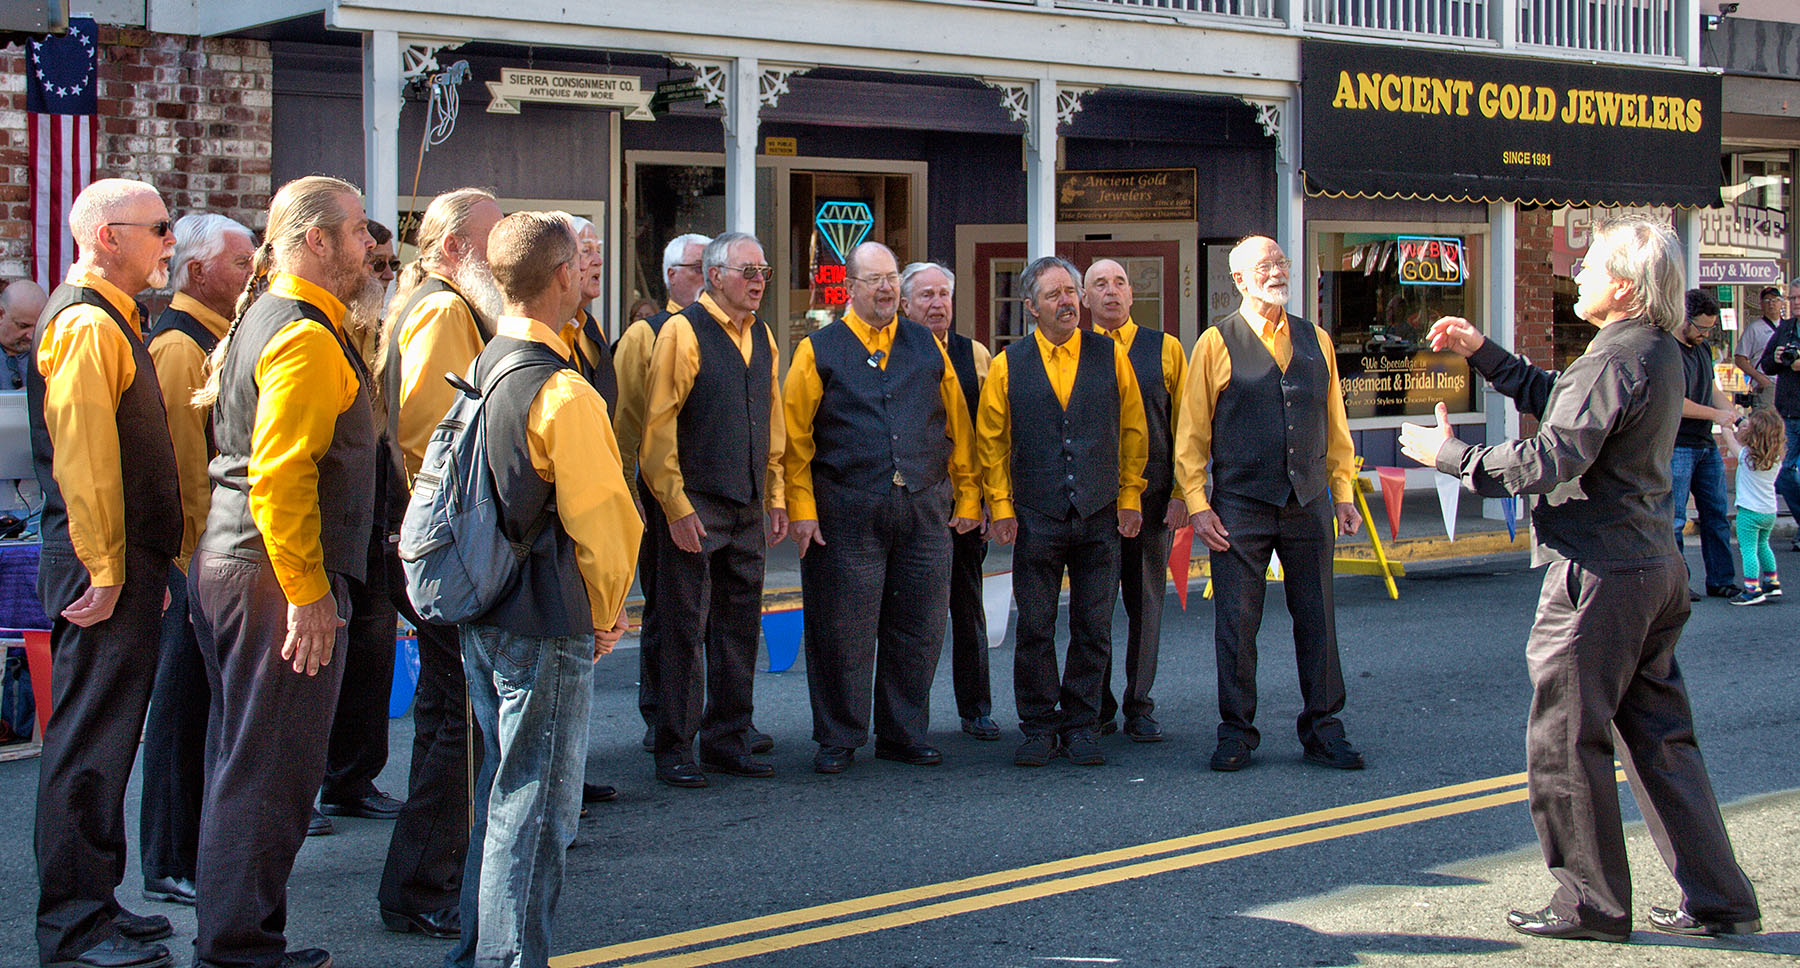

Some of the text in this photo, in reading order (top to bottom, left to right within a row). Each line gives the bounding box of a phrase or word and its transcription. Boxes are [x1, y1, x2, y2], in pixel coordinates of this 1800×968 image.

[509, 74, 634, 92] SIERRA CONSIGNMENT CO.
[529, 87, 614, 100] ANTIQUES AND MORE
[1332, 69, 1703, 133] ANCIENT GOLD JEWELERS
[1502, 151, 1551, 166] SINCE 1981
[1083, 172, 1169, 188] Ancient Gold
[1096, 187, 1152, 203] Jewelers
[1699, 202, 1785, 251] TRIKE
[1403, 260, 1460, 281] GOLD
[1700, 262, 1771, 281] ndy & More
[1361, 355, 1378, 370] We
[1380, 355, 1417, 372] Specialize
[1339, 371, 1466, 397] gagement & Bridal Rings
[1377, 396, 1395, 408] Styles
[1395, 397, 1403, 406] to
